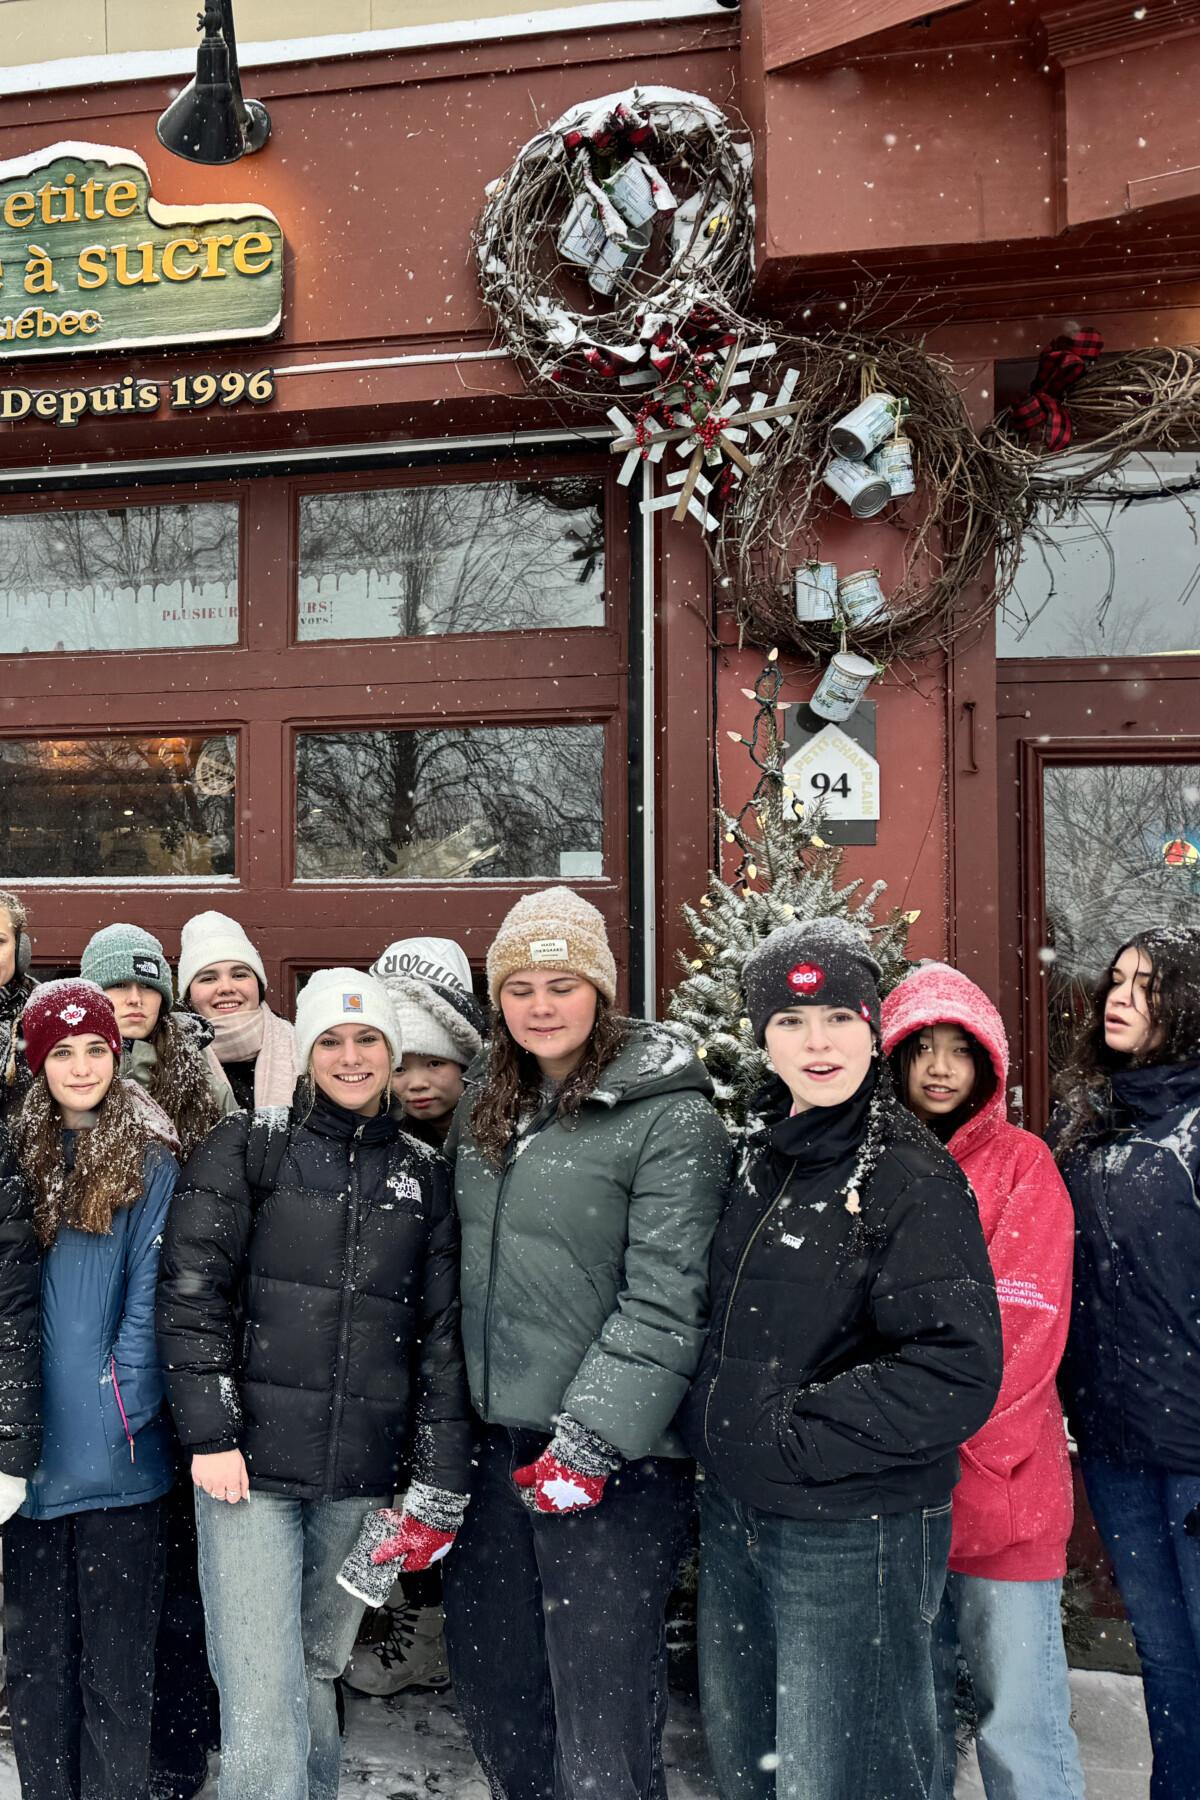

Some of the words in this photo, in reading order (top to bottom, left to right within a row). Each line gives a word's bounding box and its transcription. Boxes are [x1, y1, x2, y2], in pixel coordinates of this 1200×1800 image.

[23, 244, 58, 294] à
[77, 231, 274, 289] sucre
[0, 376, 159, 424] Depuis
[171, 368, 274, 407] 1996
[810, 772, 852, 799] 94
[792, 970, 817, 984] aei
[386, 1179, 418, 1194] NORTH
[396, 1189, 417, 1200] FACE
[998, 1278, 1038, 1290] ATLANTIC
[996, 1286, 1044, 1299] EDUCATION
[997, 1295, 1058, 1312] INTERNATIONAL
